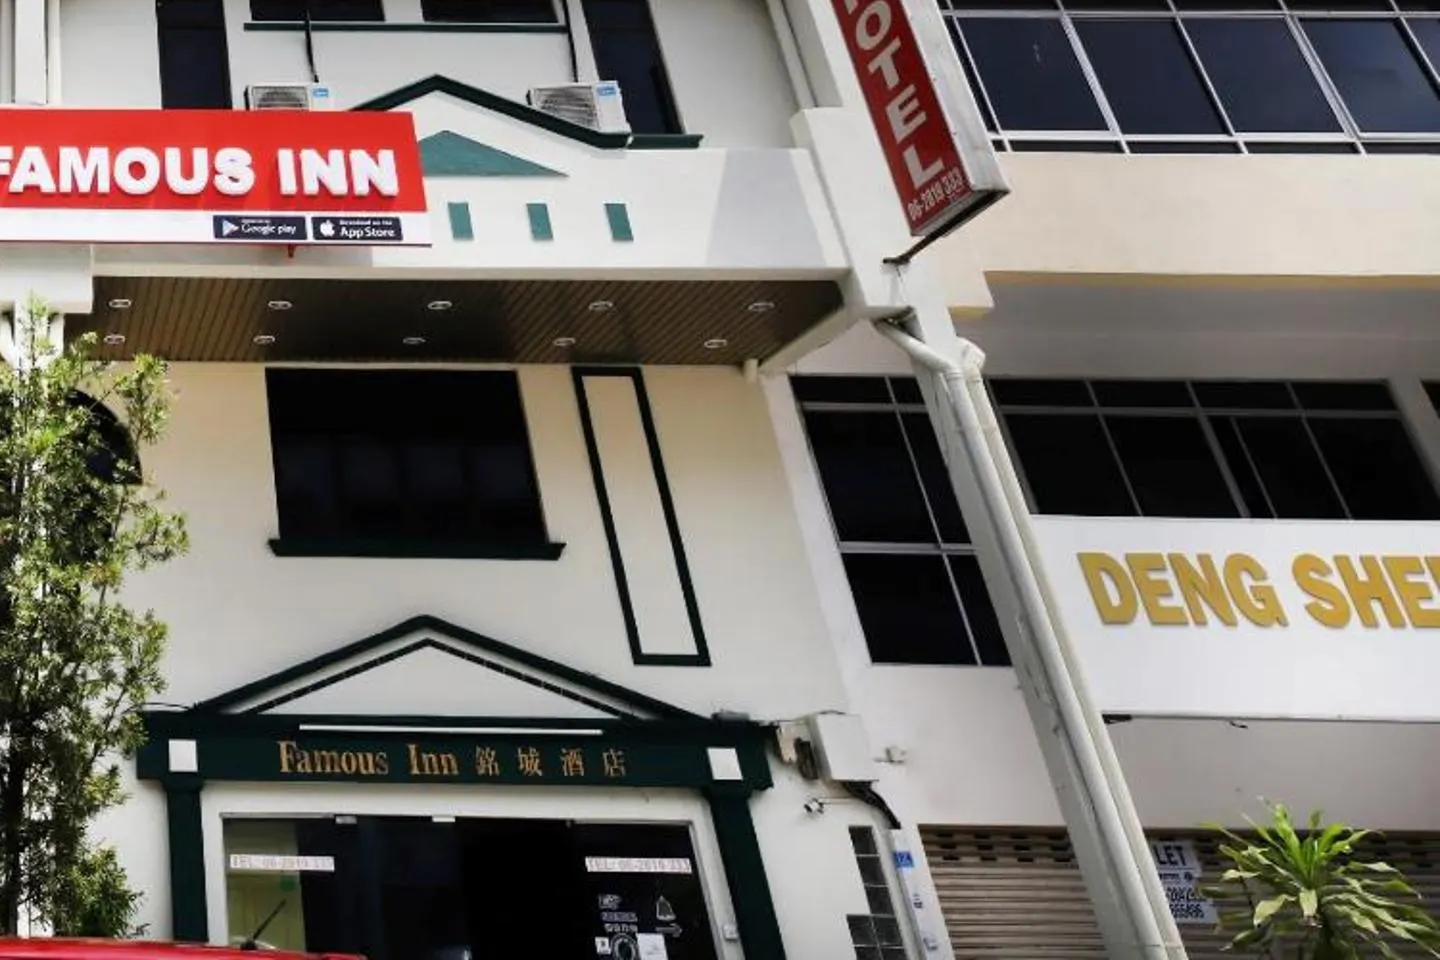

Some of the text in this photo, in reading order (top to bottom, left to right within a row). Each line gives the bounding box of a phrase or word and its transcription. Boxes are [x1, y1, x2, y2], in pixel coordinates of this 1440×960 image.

[276, 148, 400, 198] INN
[241, 223, 296, 235] Google play
[340, 226, 395, 238] App Store
[1077, 552, 1440, 628] DENG SHE
[279, 741, 458, 775] Famous Inn
